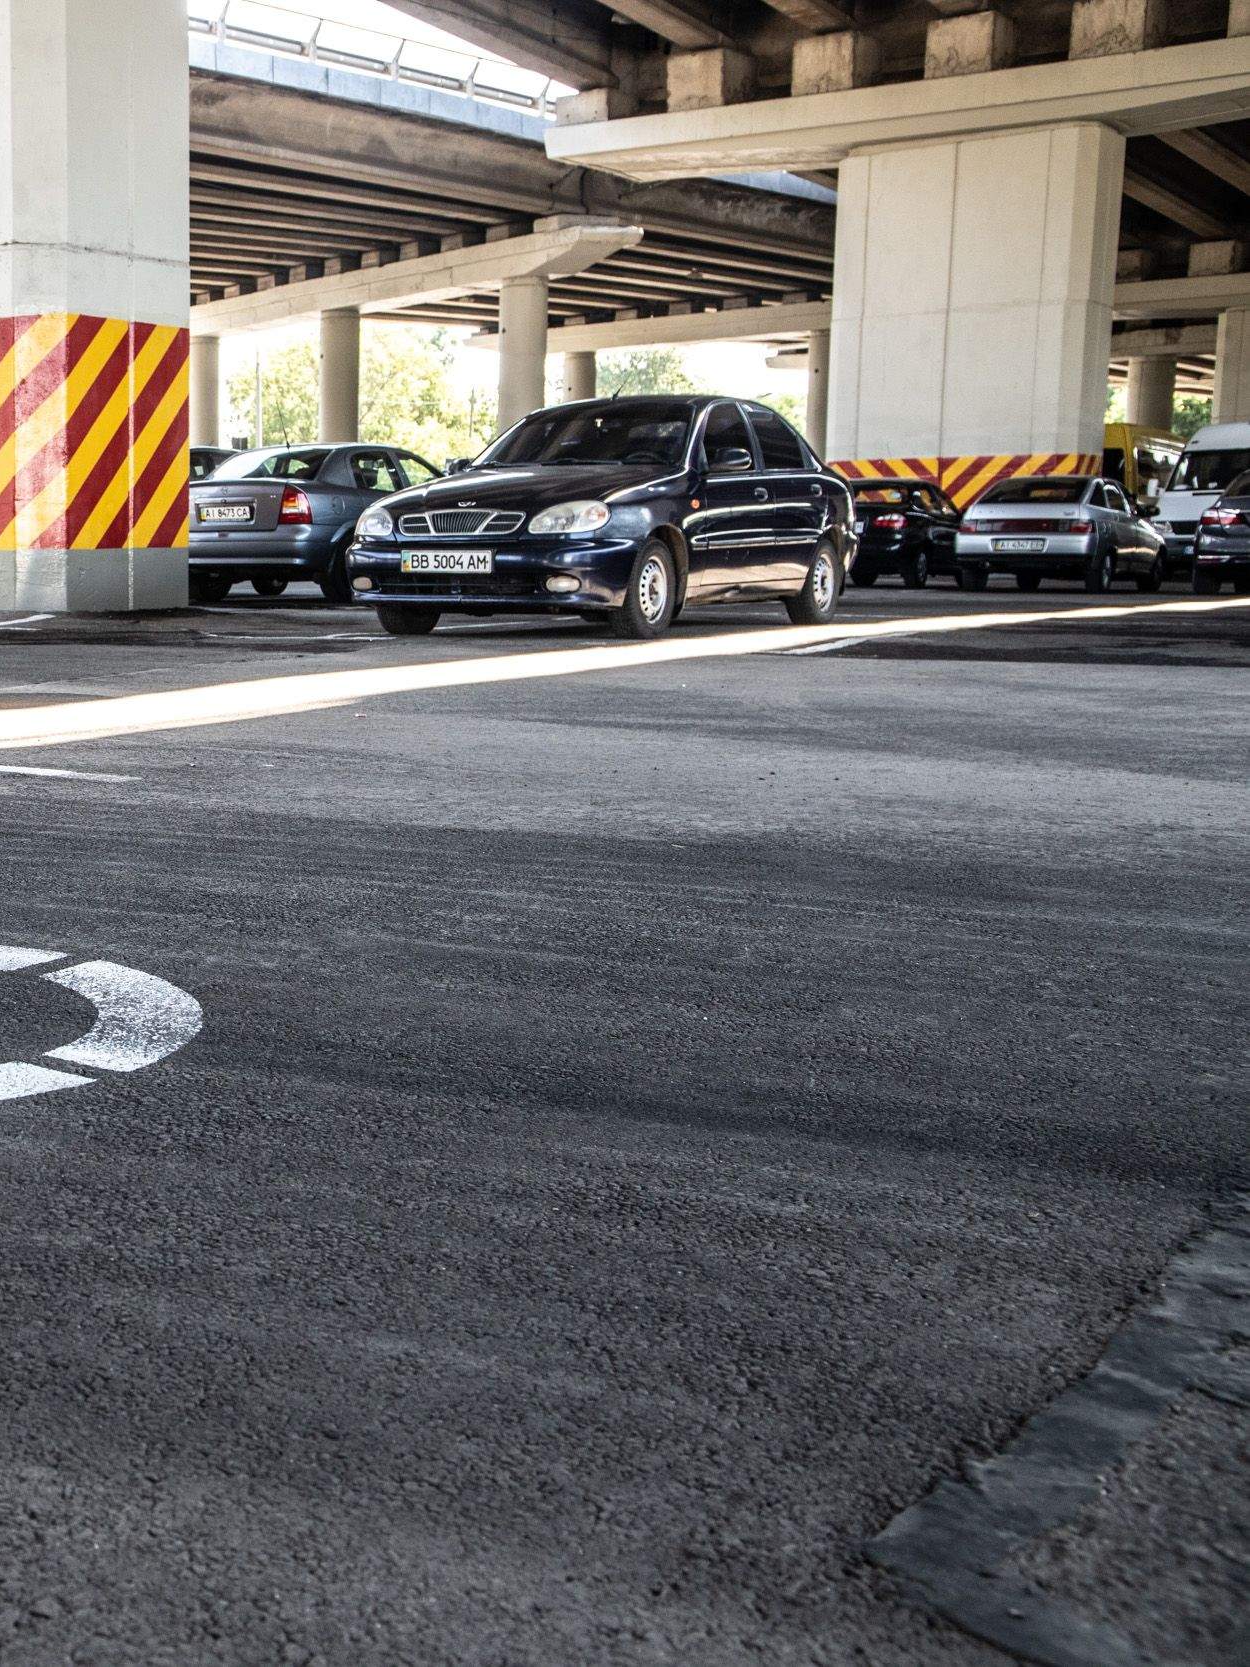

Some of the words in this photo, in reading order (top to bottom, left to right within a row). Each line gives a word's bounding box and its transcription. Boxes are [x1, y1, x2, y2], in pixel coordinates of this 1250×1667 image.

[206, 509, 215, 518] AI
[237, 508, 248, 517] CA
[411, 554, 429, 569] BB
[434, 554, 464, 569] 5004
[467, 555, 486, 570] AM
